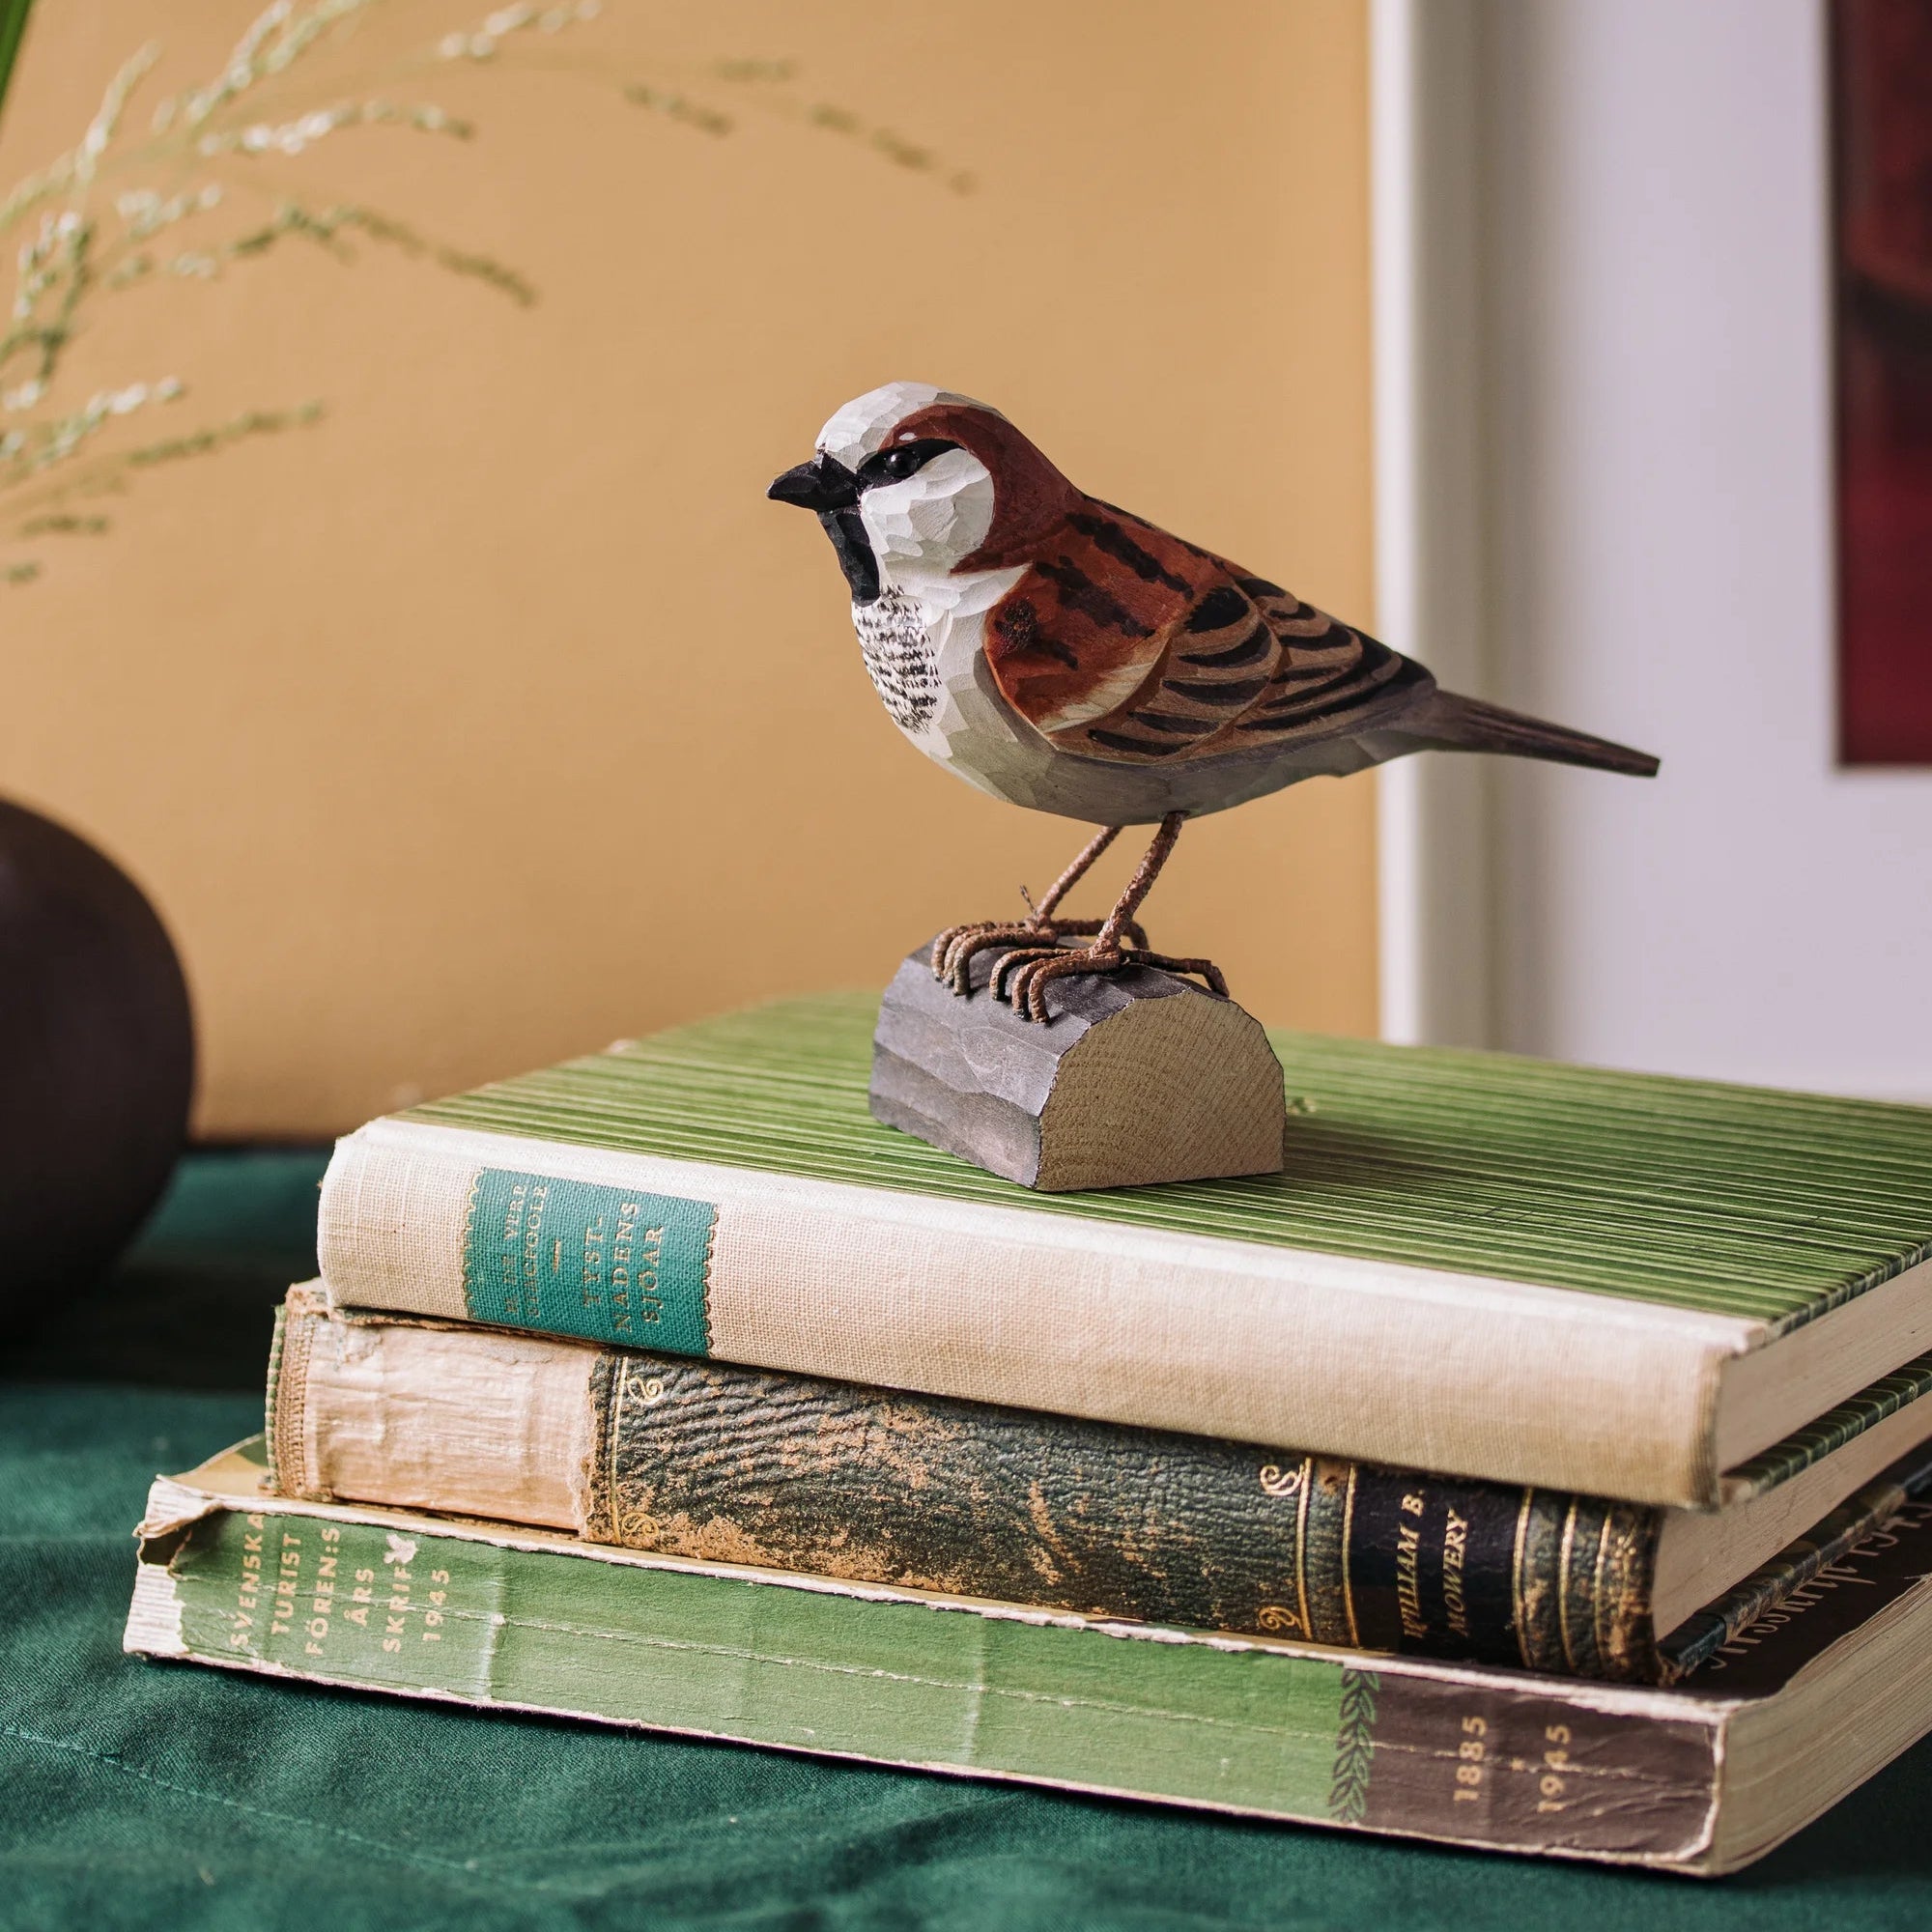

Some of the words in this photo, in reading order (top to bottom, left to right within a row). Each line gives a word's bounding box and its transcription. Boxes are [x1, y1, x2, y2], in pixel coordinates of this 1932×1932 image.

[503, 1183, 527, 1241] VERE
[523, 1184, 549, 1319] STACPOOLE
[582, 1215, 604, 1307] TYST-
[612, 1202, 640, 1334] NADENS
[638, 1224, 665, 1325] SJÖAR
[1402, 1489, 1426, 1518] B.
[230, 1514, 266, 1648] SVENSKA
[270, 1532, 302, 1636] TURIST
[303, 1526, 342, 1657] FÖREN:S
[343, 1568, 376, 1629] ÅRS
[382, 1546, 415, 1654] SKRIF
[422, 1569, 450, 1643] 1945
[1397, 1521, 1429, 1639] WILLIAM
[1442, 1507, 1471, 1639] MOWERY
[1453, 1716, 1489, 1803] 1885
[1537, 1722, 1573, 1813] 1945
